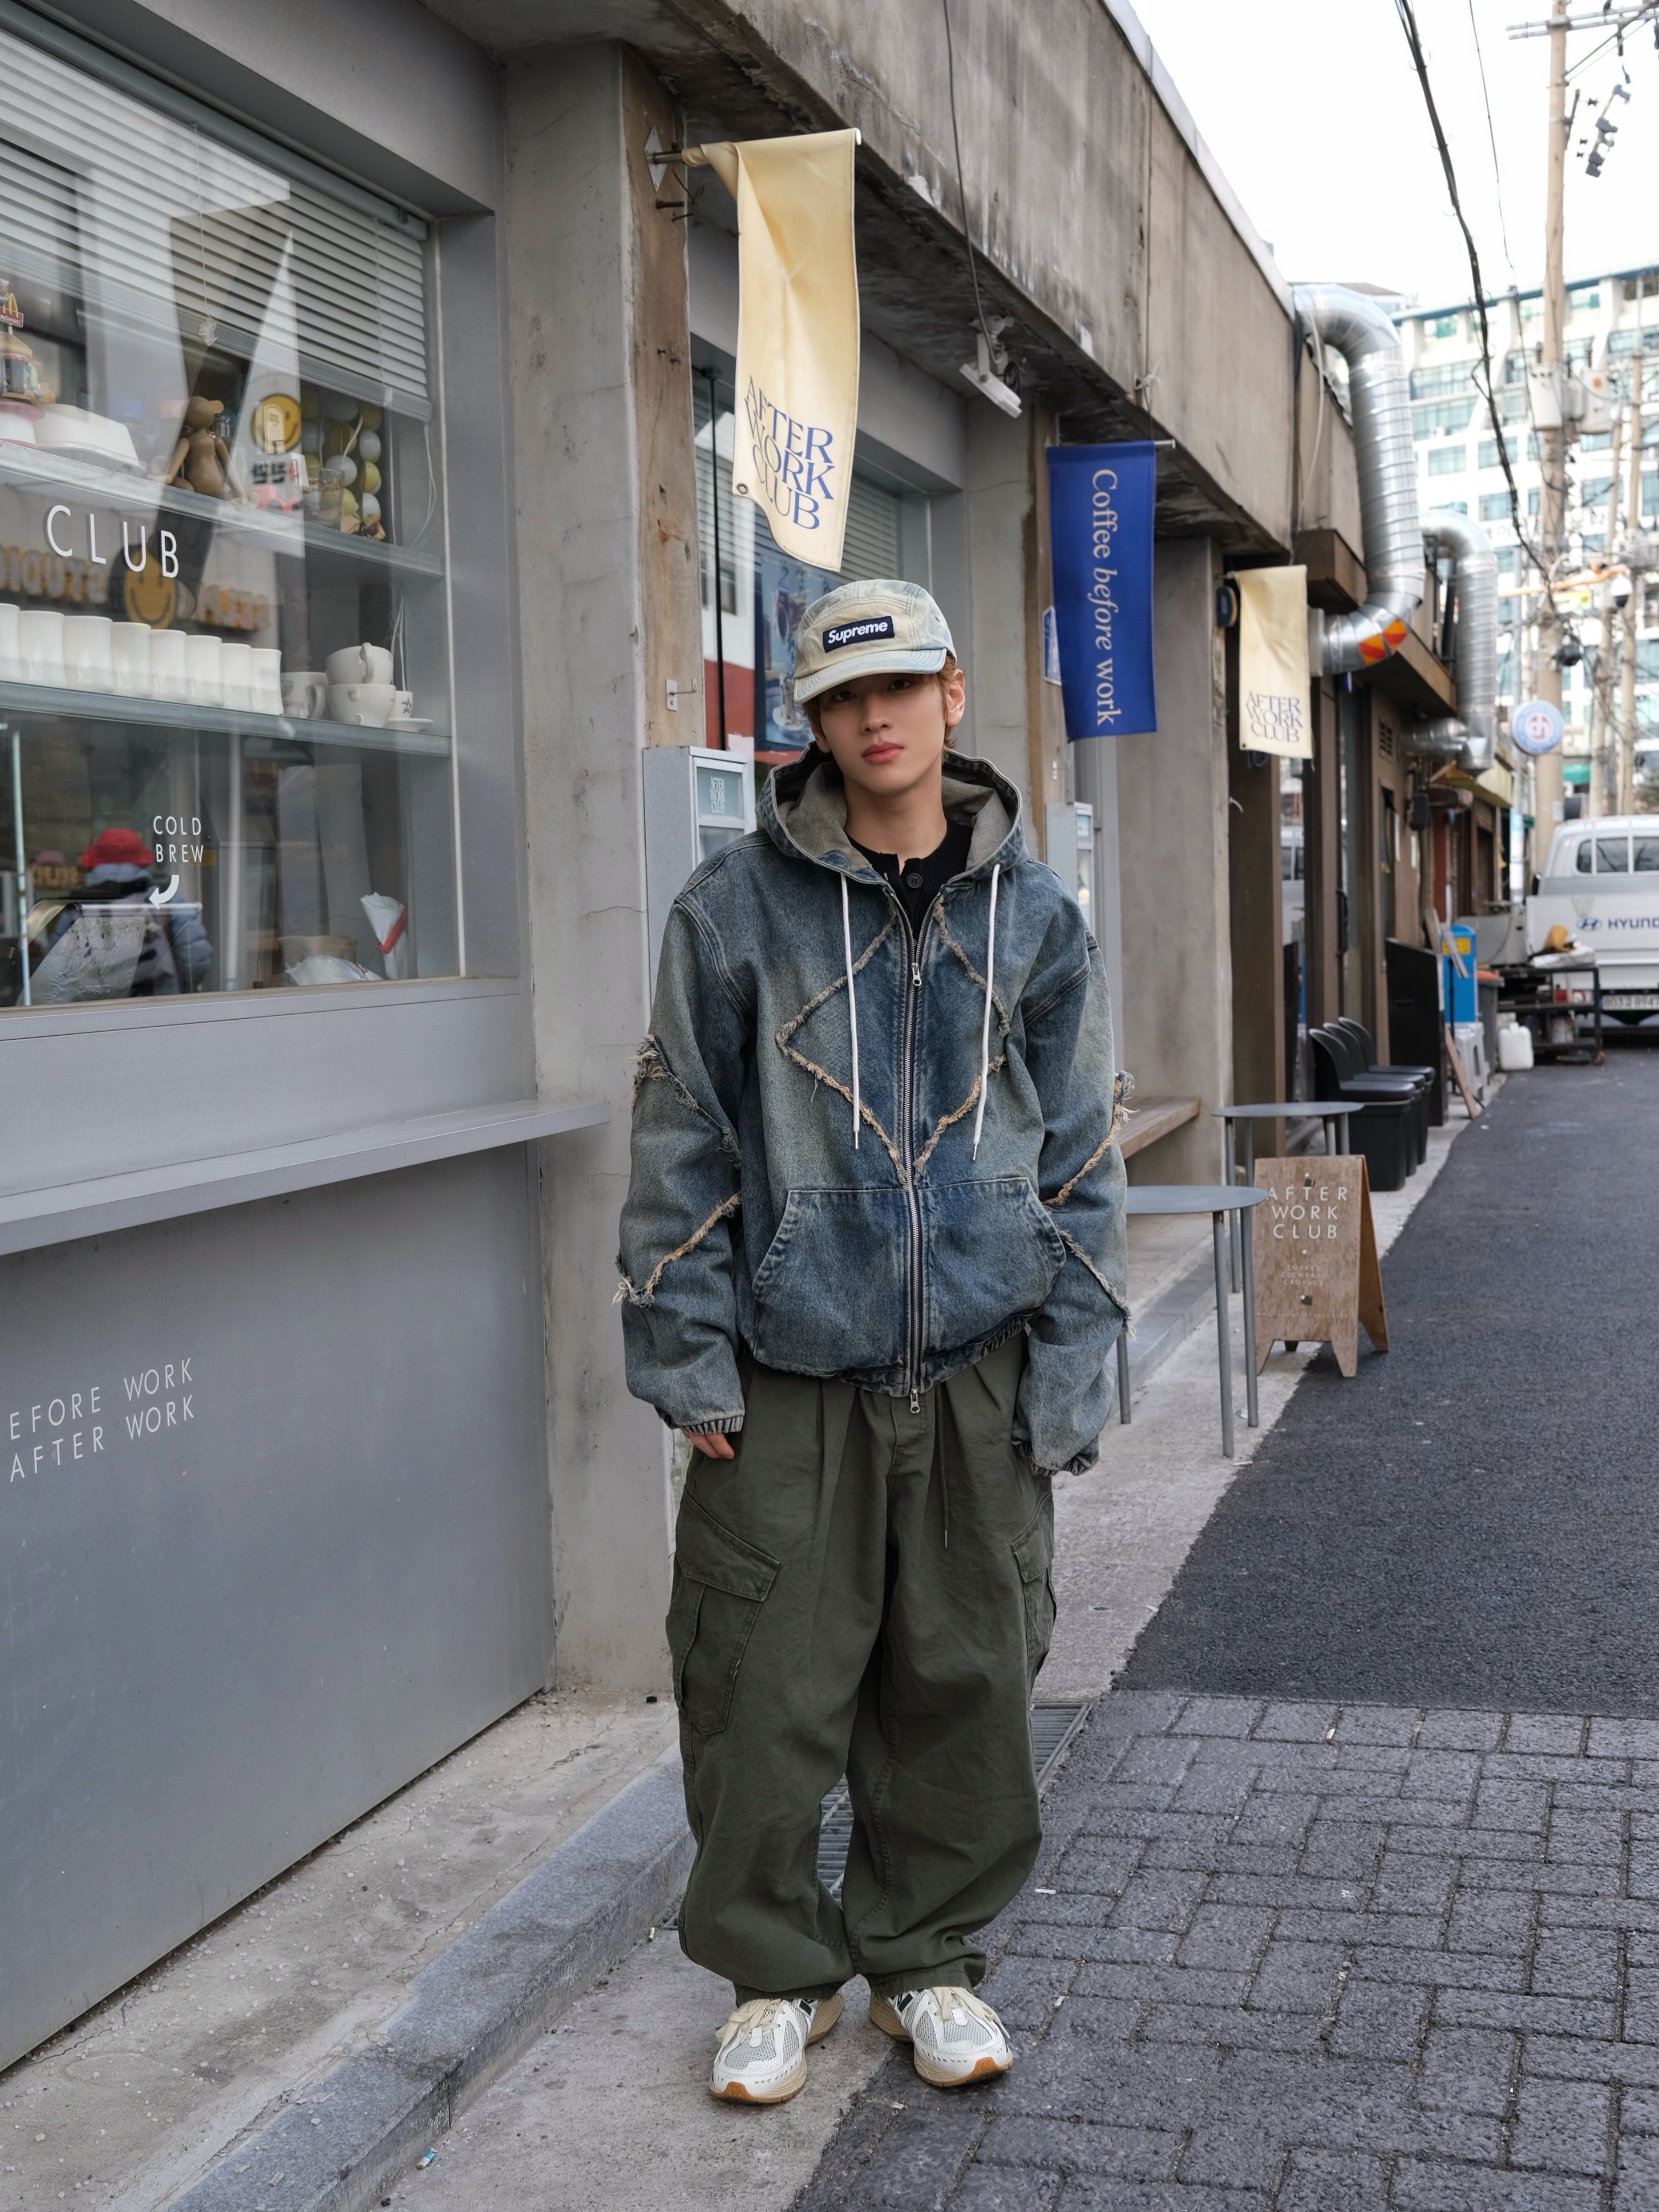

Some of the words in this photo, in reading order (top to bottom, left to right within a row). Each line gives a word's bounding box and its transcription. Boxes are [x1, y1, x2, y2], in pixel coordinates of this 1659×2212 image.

[746, 375, 833, 464] AFTER
[744, 398, 835, 500] WORK
[752, 444, 820, 529] CLUB
[1092, 469, 1118, 559] Coffee
[47, 505, 179, 578] CLUB
[1087, 567, 1119, 650] before
[828, 622, 888, 643] Supreme
[1096, 657, 1122, 727] work
[1246, 691, 1301, 715] AFTER
[1246, 705, 1303, 728] WORK
[1251, 721, 1300, 743] CLUB
[710, 777, 725, 791] AFTER
[710, 789, 726, 803] WORK
[711, 801, 725, 814] CLUB
[153, 815, 201, 836] COLD
[156, 844, 204, 862] BREW
[1266, 1186, 1348, 1201] AFTER
[1272, 1205, 1338, 1220] WORK
[1273, 1224, 1337, 1239] CLUB
[124, 1358, 192, 1401] WORK
[10, 1426, 104, 1482] AFTER
[126, 1395, 194, 1440] WORK
